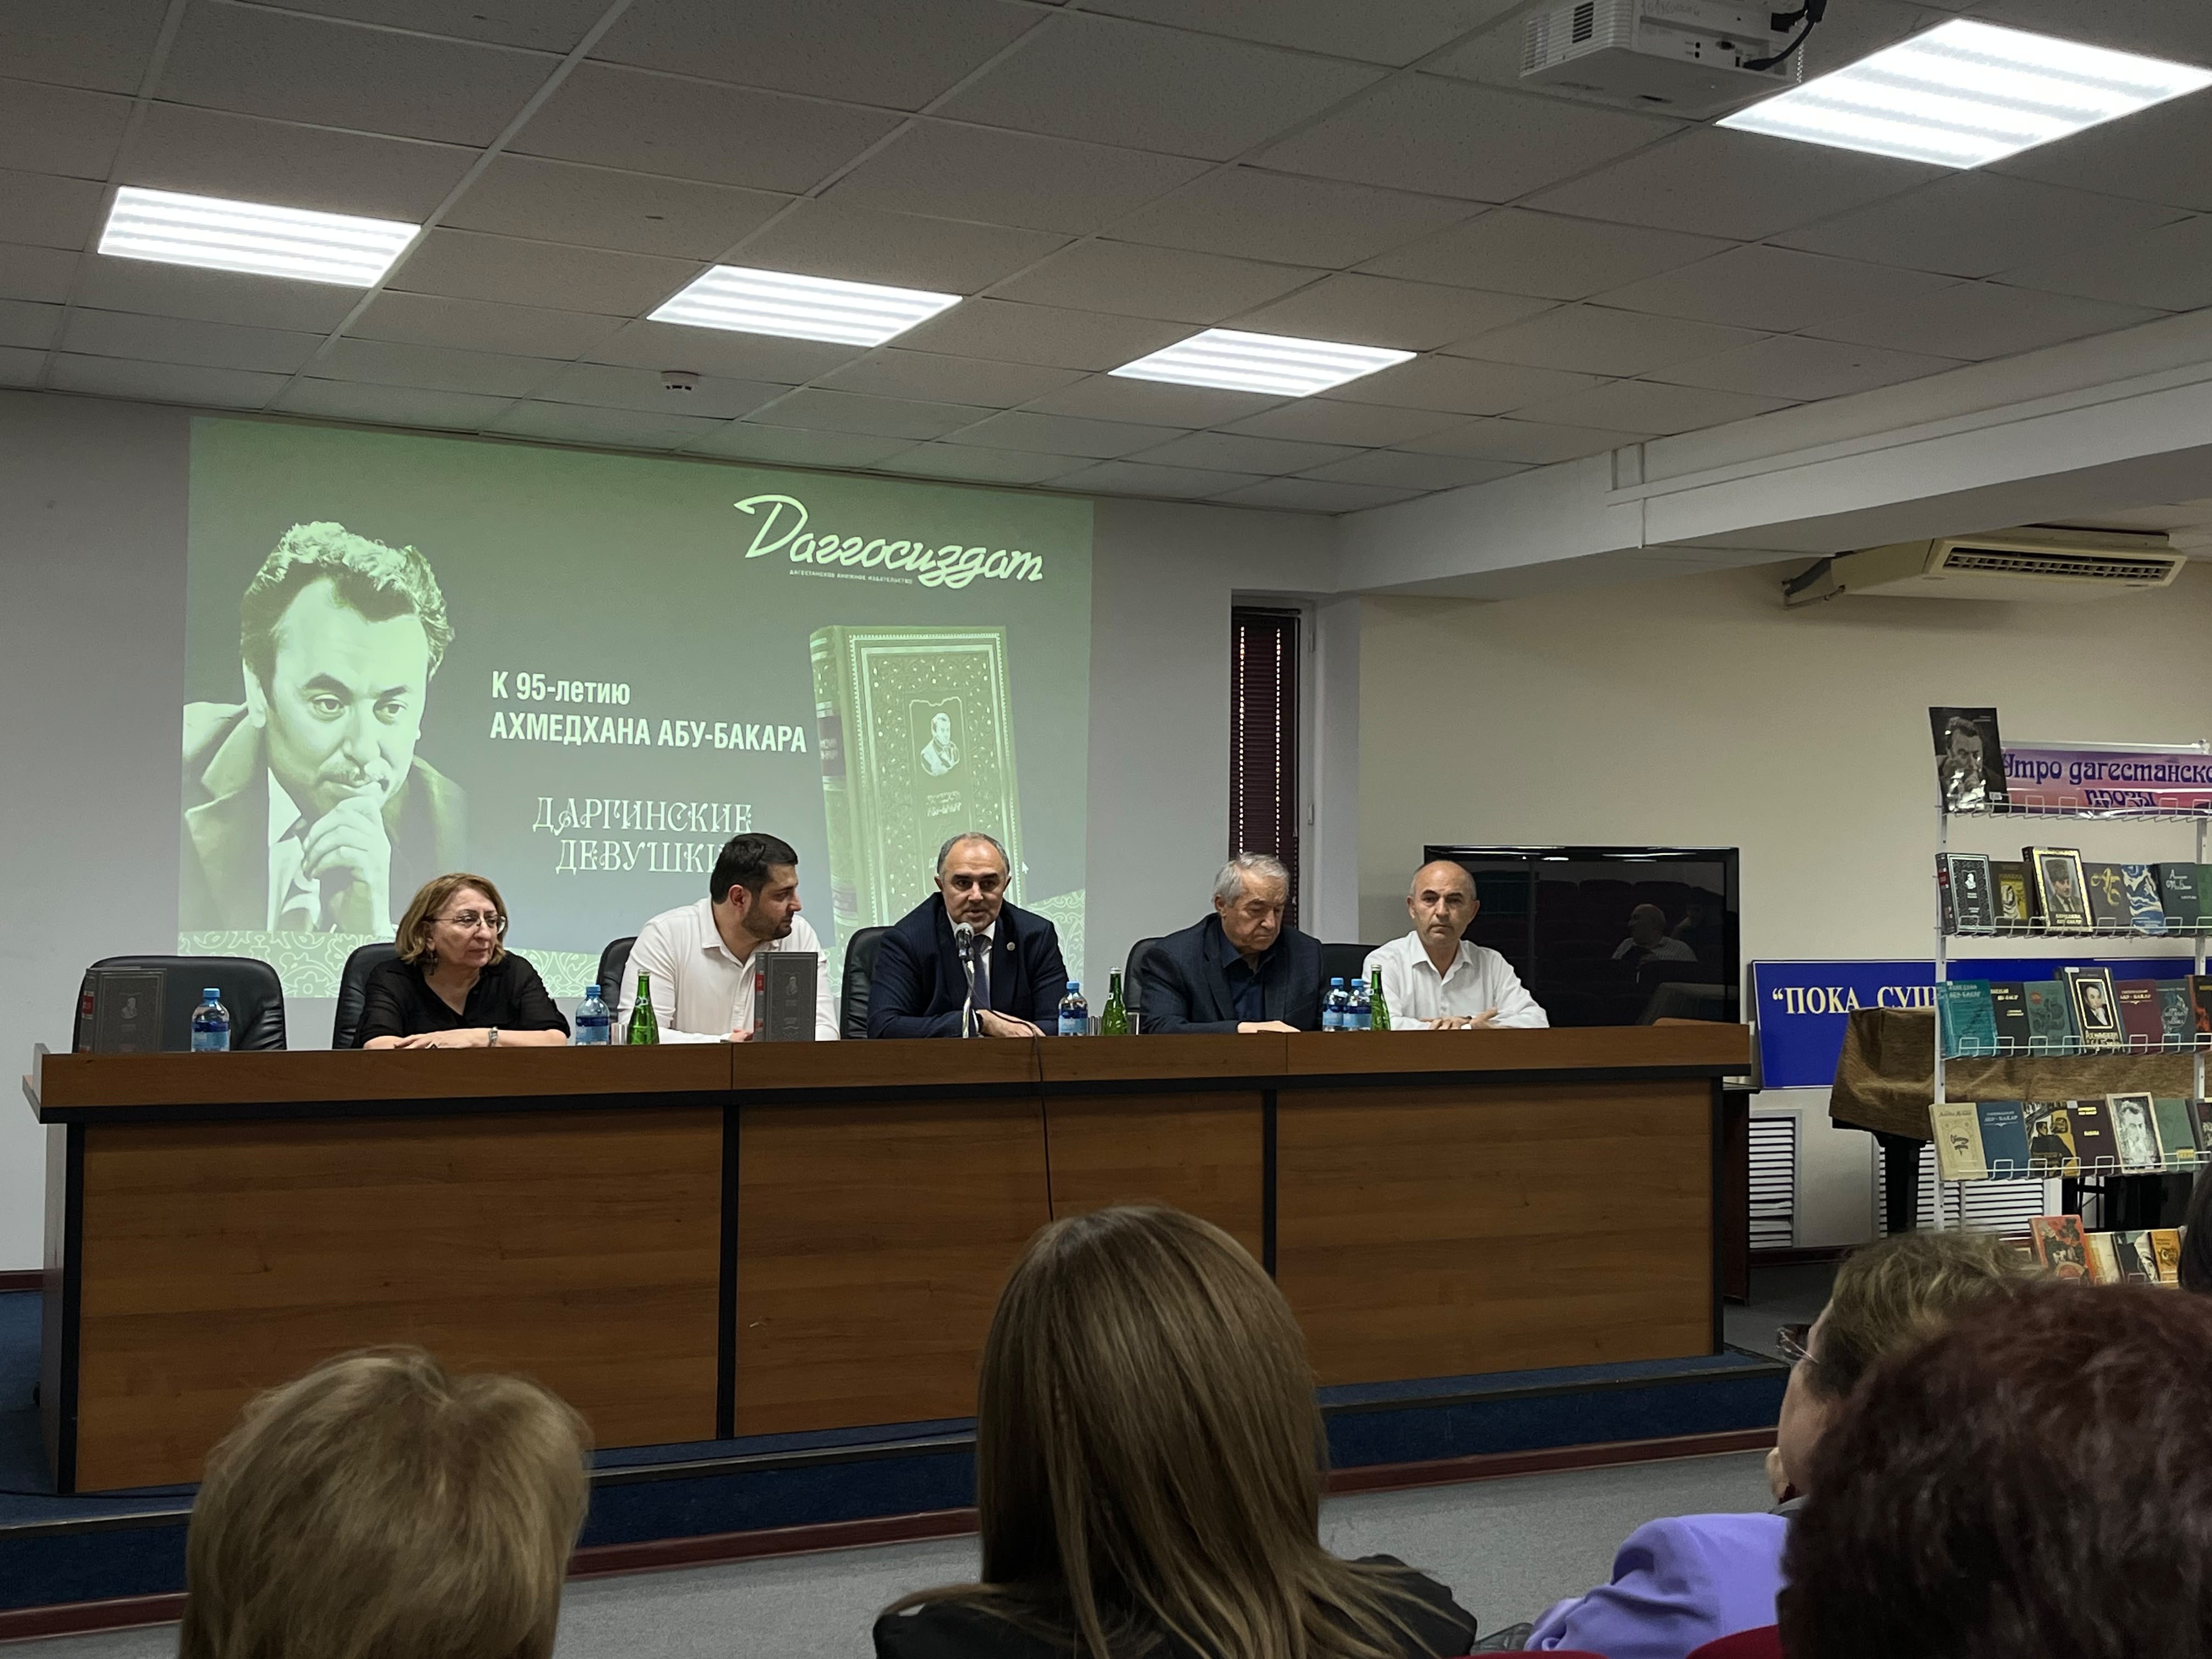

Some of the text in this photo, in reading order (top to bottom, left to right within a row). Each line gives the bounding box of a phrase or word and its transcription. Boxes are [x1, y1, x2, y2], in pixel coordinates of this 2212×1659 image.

[492, 670, 631, 705] К 95-летию
[489, 711, 651, 746] АХМЕДХАНА
[657, 719, 807, 753] АБУ-БАКАРА
[533, 797, 752, 836] ДАРГИНСКИЕ
